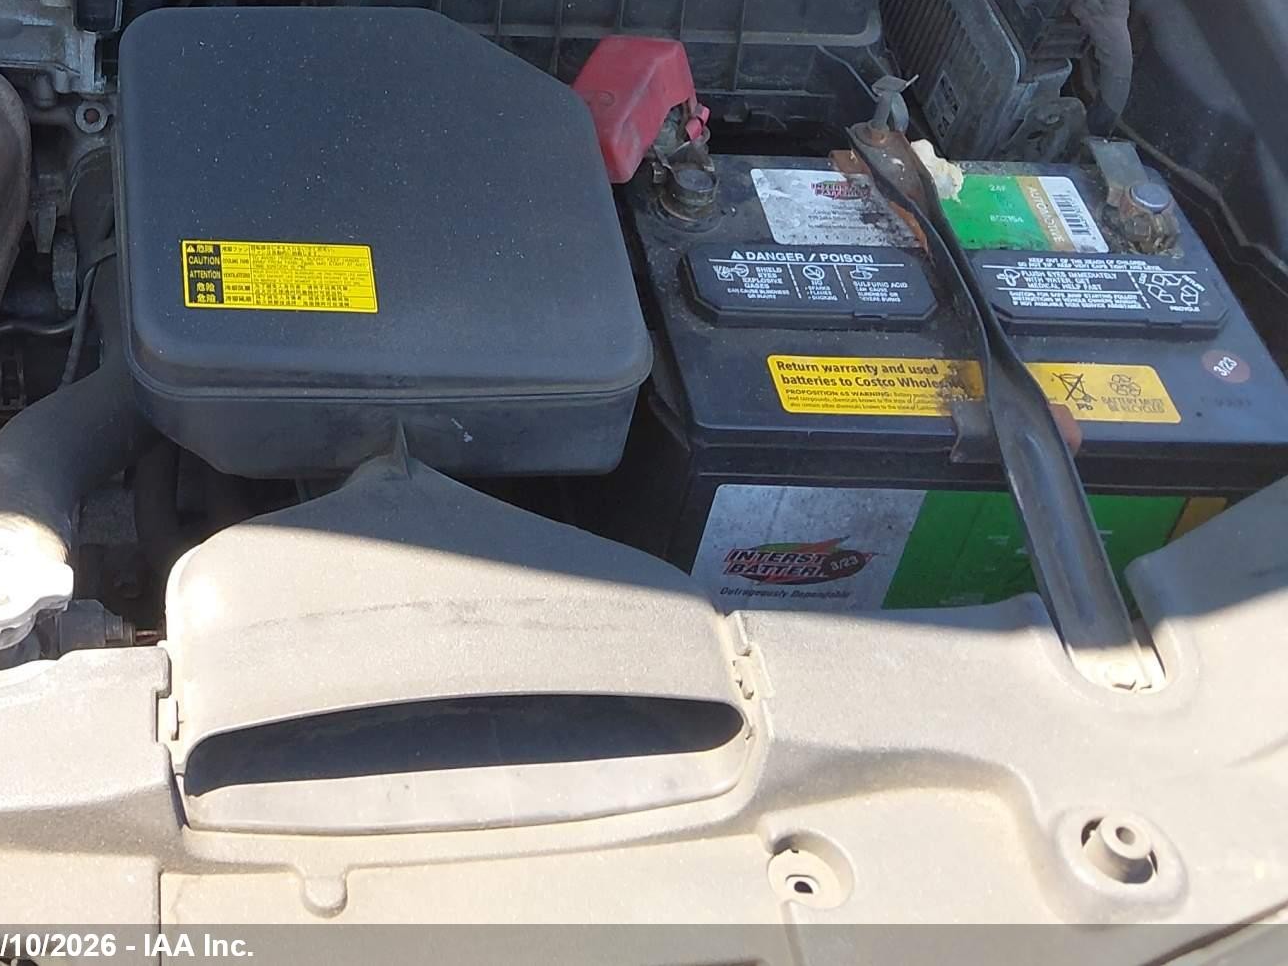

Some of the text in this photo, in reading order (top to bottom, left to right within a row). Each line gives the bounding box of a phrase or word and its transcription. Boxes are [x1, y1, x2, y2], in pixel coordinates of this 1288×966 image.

[188, 256, 220, 265] CAUTION
[745, 251, 805, 262] DANGER
[820, 253, 874, 264] POISON
[189, 269, 221, 279] ATTENTION
[775, 361, 938, 375] Return warranty and used
[1213, 356, 1238, 377] 3/23
[780, 374, 837, 386] batteries
[839, 376, 853, 387] to
[854, 376, 896, 387] Costco
[1076, 402, 1094, 411] Pb
[726, 548, 828, 564] INTERST
